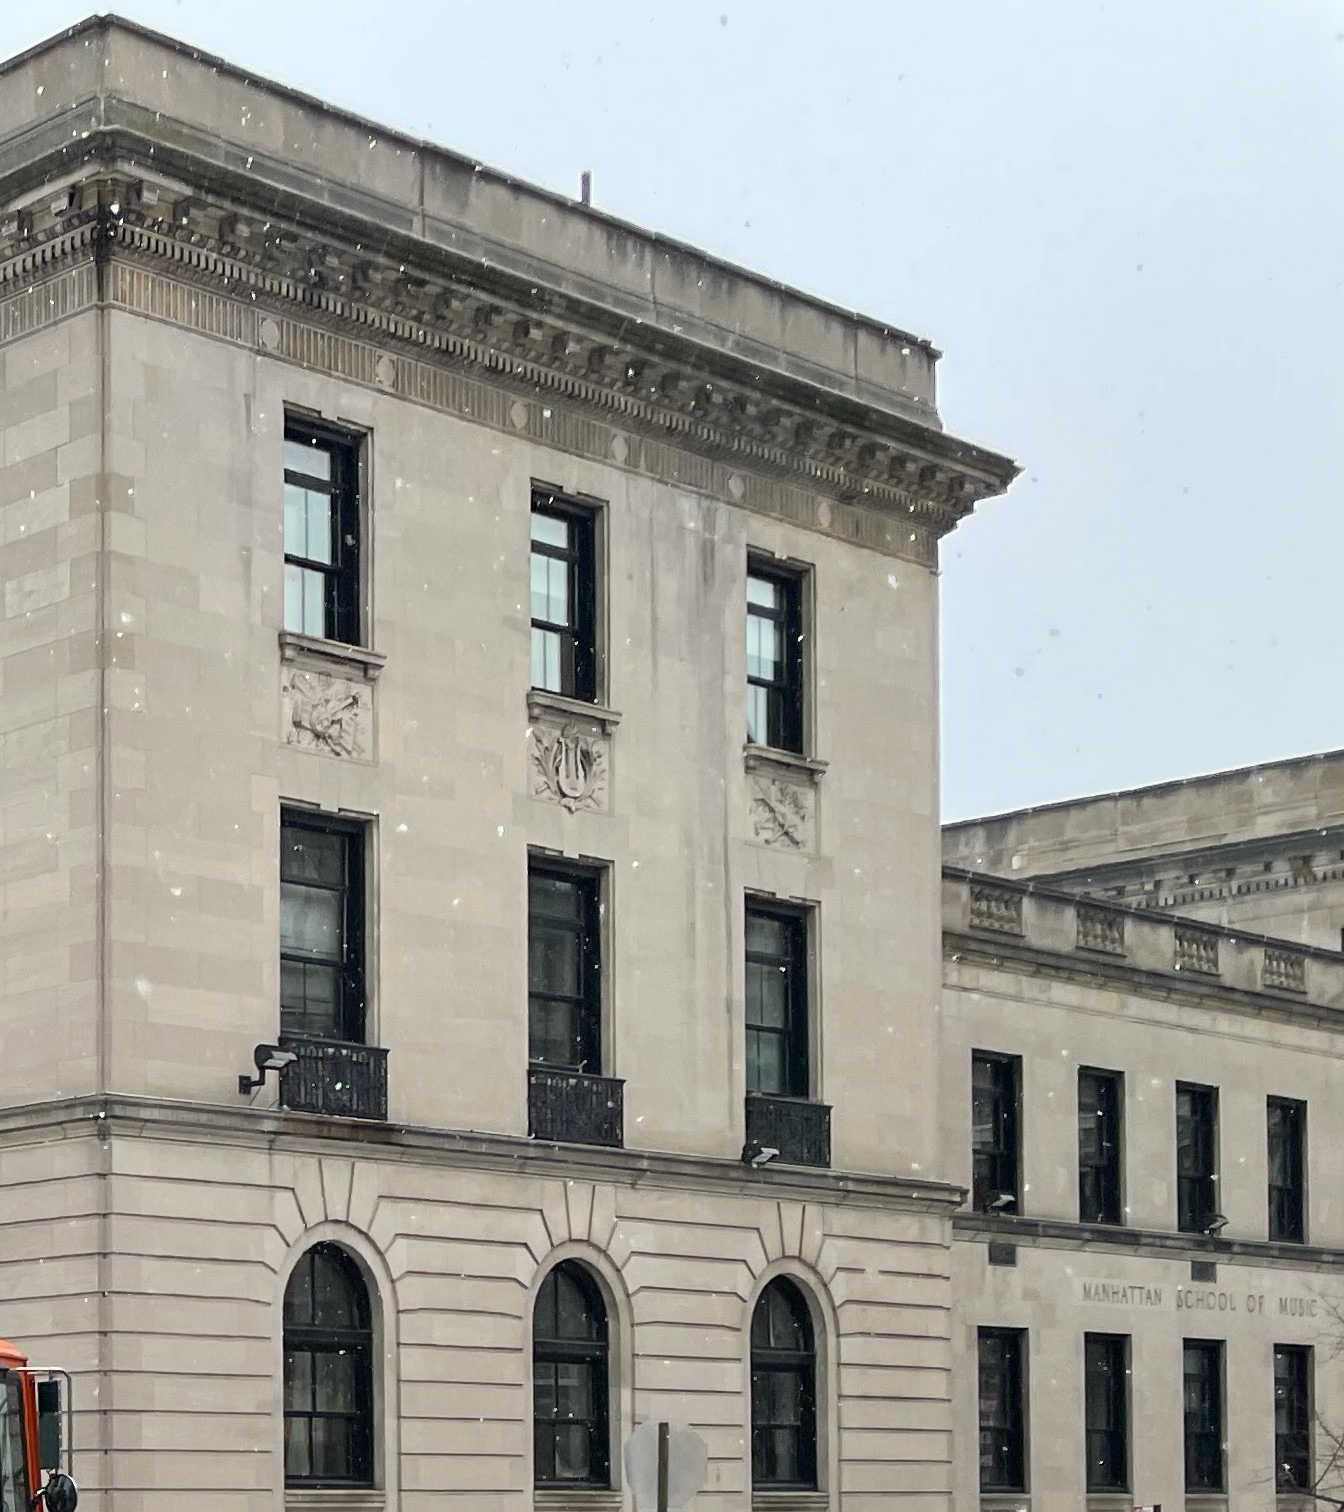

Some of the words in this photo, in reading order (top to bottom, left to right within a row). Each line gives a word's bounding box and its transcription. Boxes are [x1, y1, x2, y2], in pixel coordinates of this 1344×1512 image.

[1083, 1282, 1162, 1306] MANHATTAN
[1176, 1288, 1237, 1312] SCHOOL
[1247, 1294, 1264, 1314] OF
[1279, 1296, 1318, 1317] MUSIC
